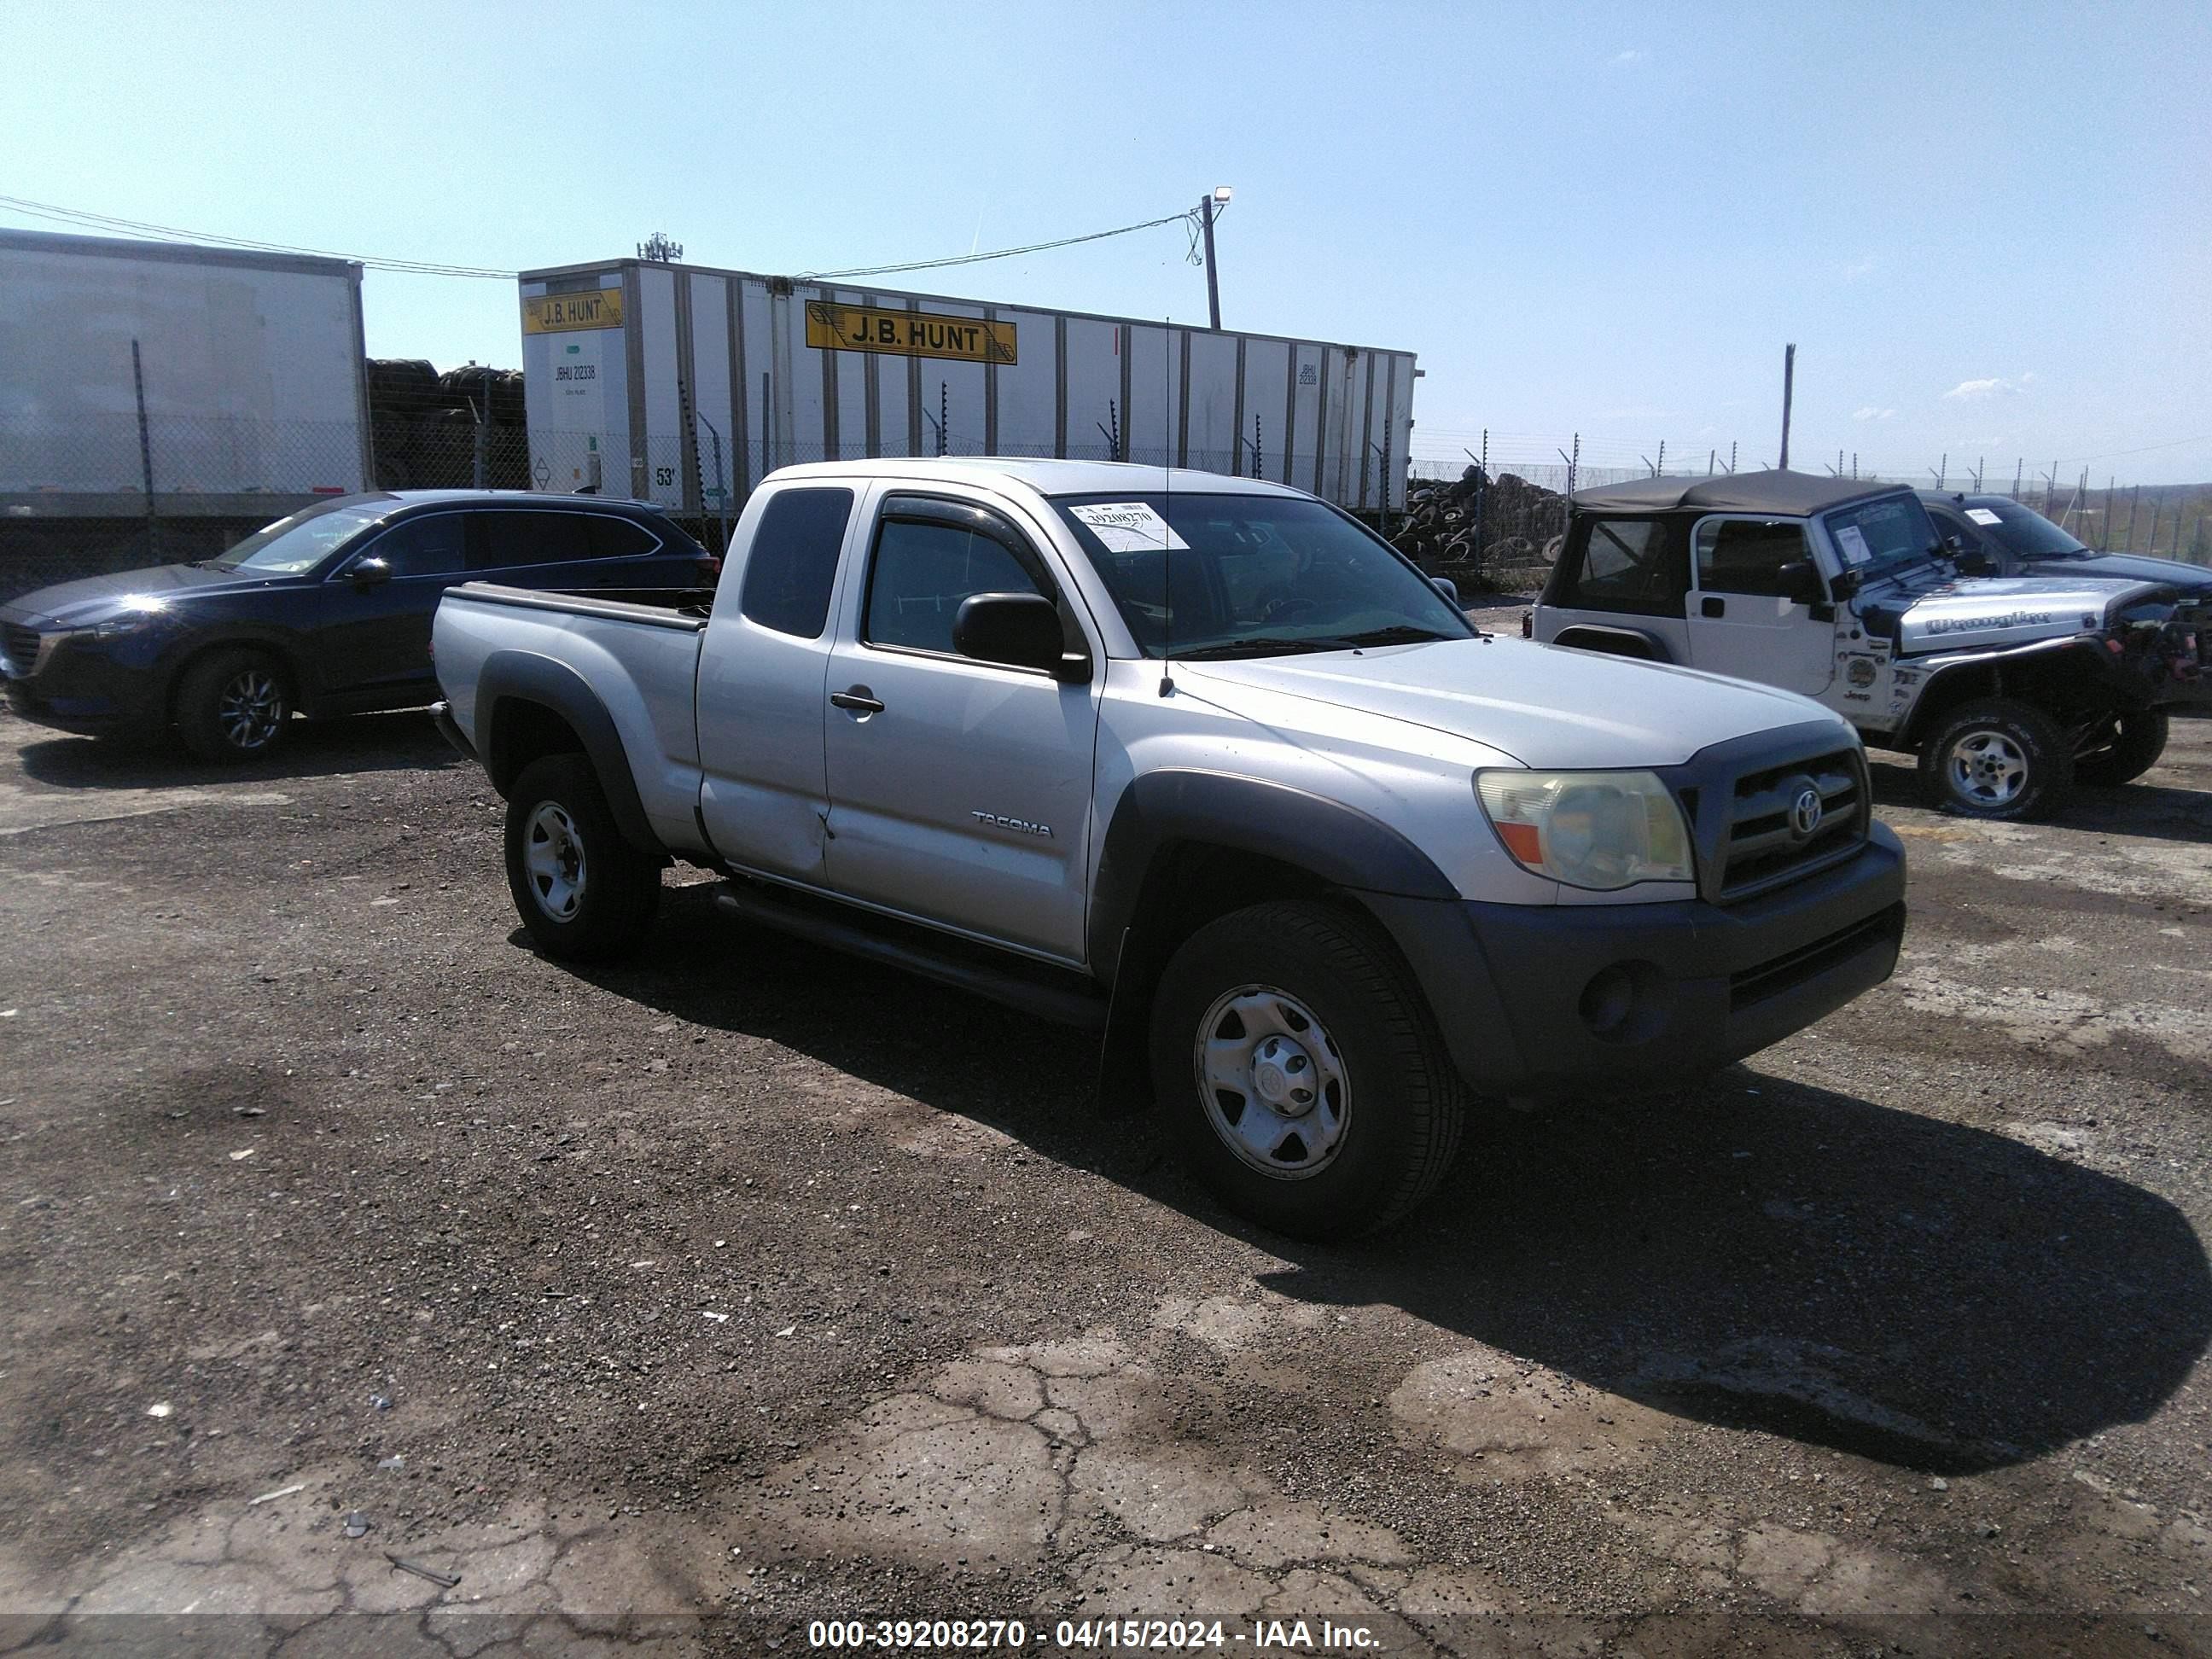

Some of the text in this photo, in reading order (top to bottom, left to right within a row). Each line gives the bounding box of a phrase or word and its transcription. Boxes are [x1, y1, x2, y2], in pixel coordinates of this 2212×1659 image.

[544, 299, 601, 324] J.B. HUNT
[852, 317, 979, 351] J.B. HUNT
[556, 366, 573, 381] JBHU
[1087, 512, 1153, 524] 39208270
[1925, 611, 2052, 634] Wrangler
[1843, 690, 1871, 701] Jeep
[971, 810, 1054, 838] TACOMA
